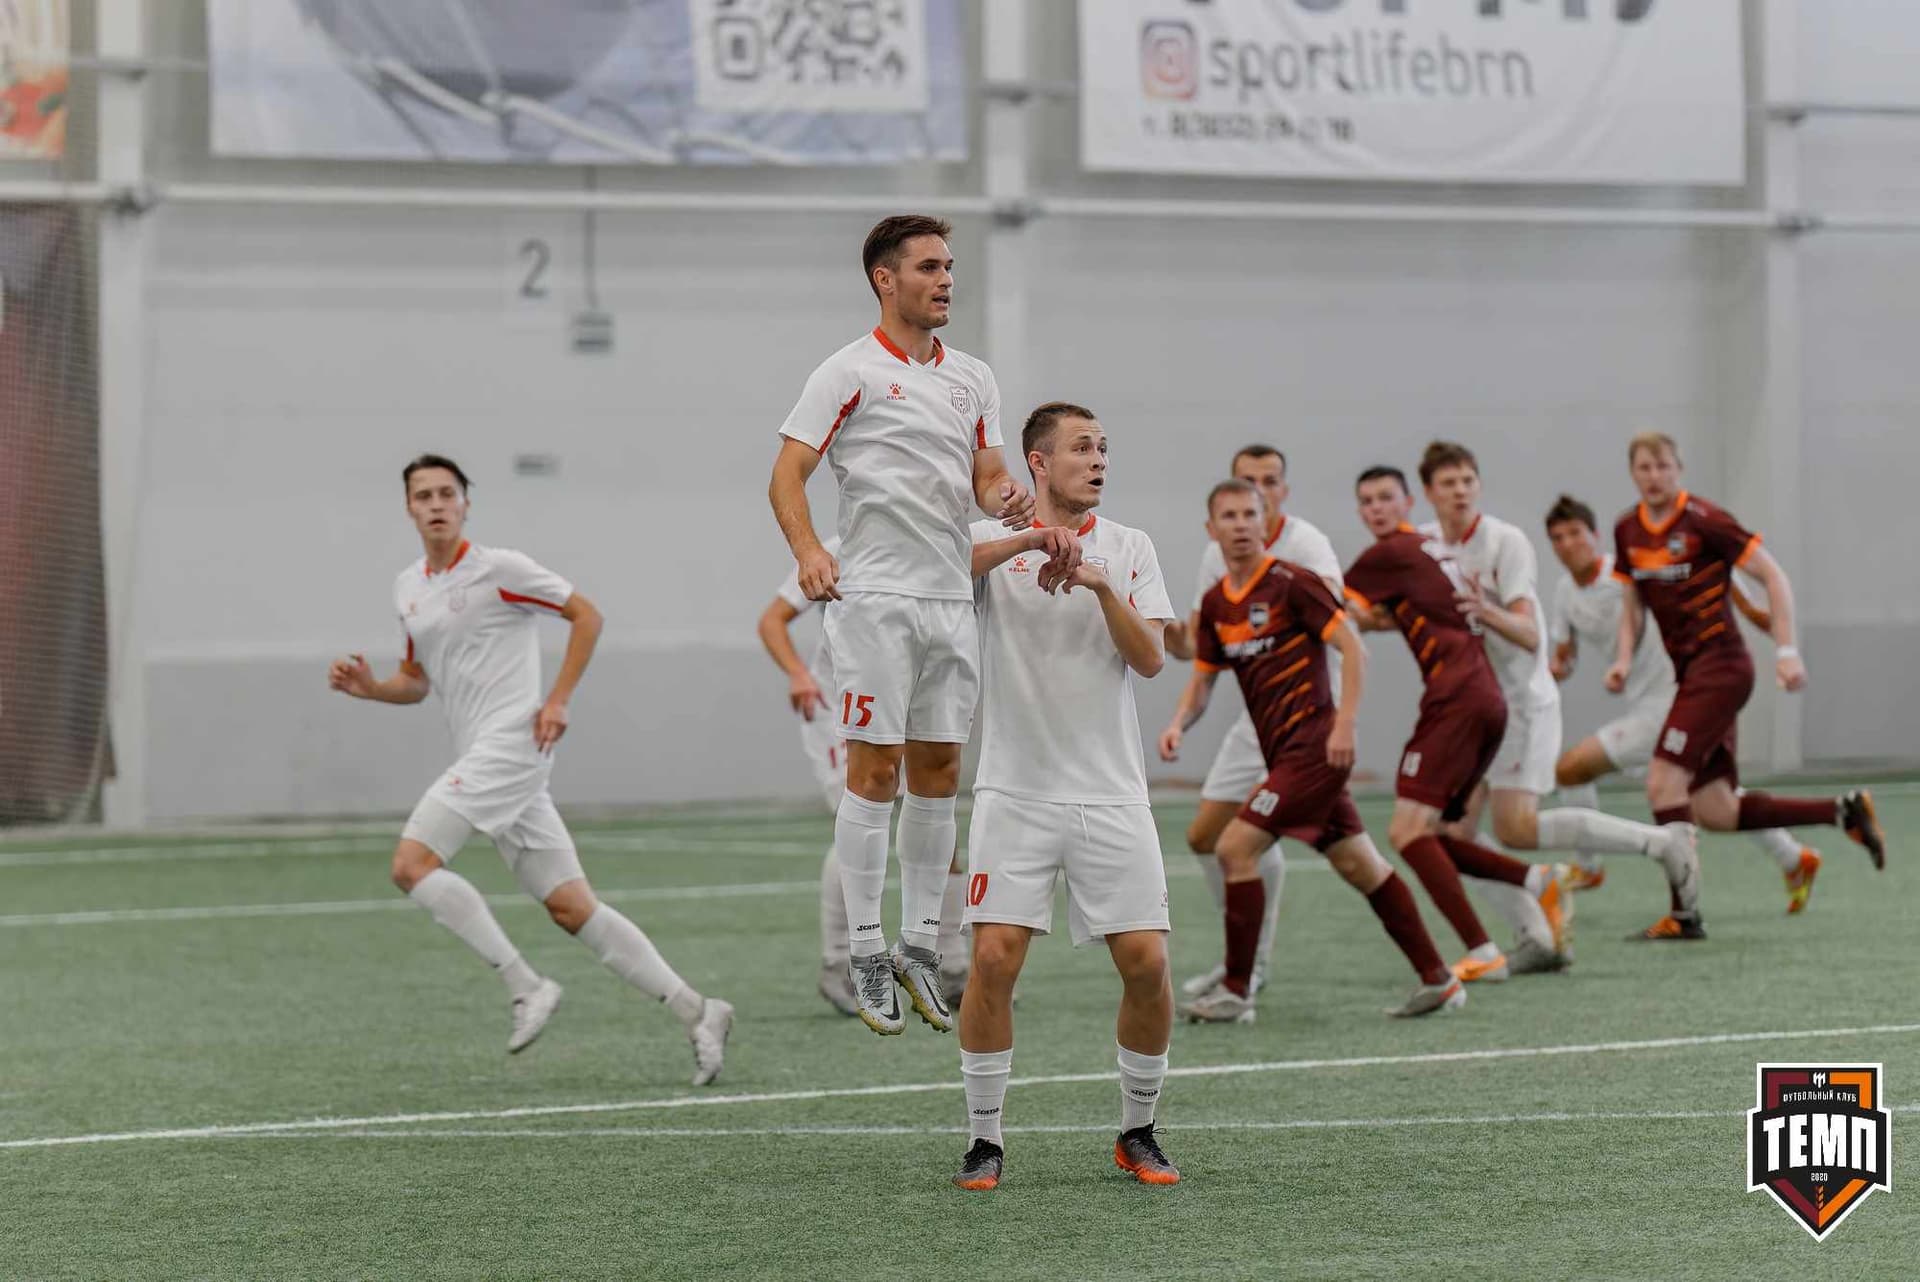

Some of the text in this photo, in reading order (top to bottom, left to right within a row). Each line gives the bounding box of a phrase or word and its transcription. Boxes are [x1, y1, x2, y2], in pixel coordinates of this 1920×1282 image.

[1208, 32, 1535, 101] sportlifebrn
[519, 239, 551, 298] 2
[842, 691, 875, 728] 15
[966, 873, 989, 907] 0
